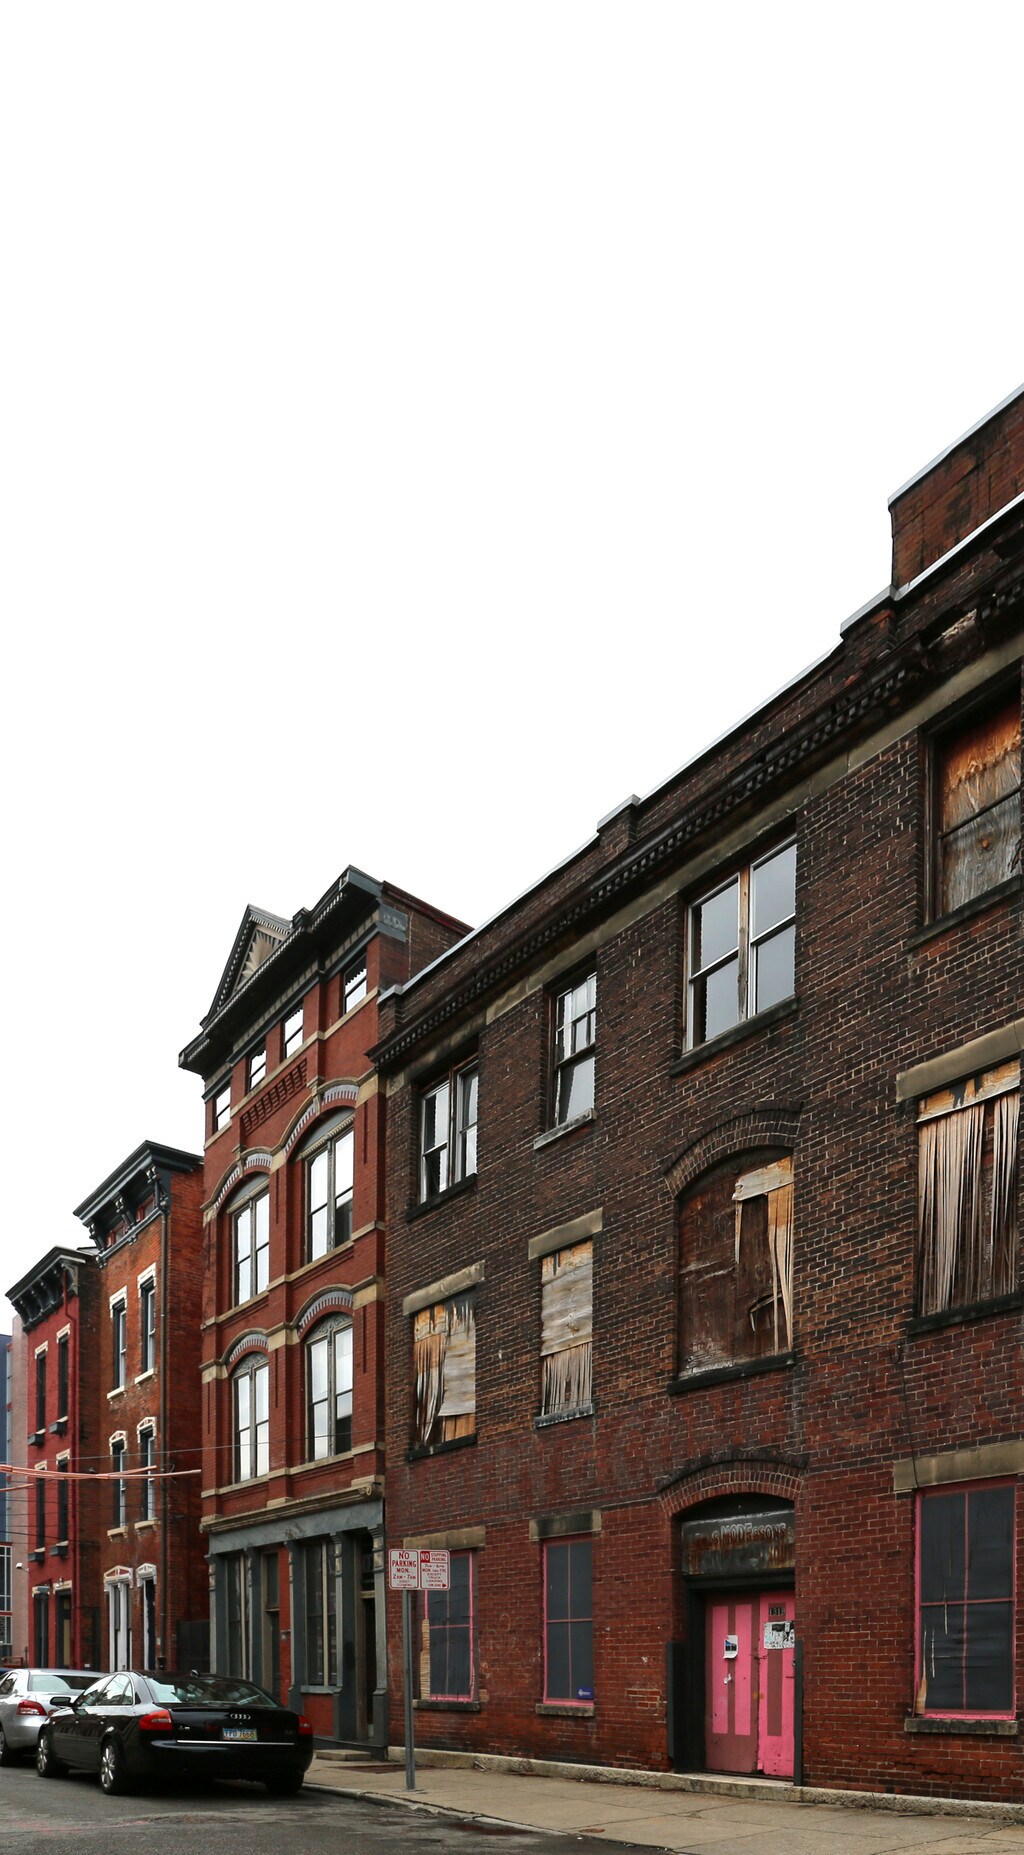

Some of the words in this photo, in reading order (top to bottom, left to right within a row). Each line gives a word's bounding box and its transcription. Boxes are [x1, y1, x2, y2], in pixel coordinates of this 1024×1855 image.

[398, 1552, 410, 1560] NO
[420, 1553, 429, 1561] NO
[391, 1560, 417, 1568] PARKING
